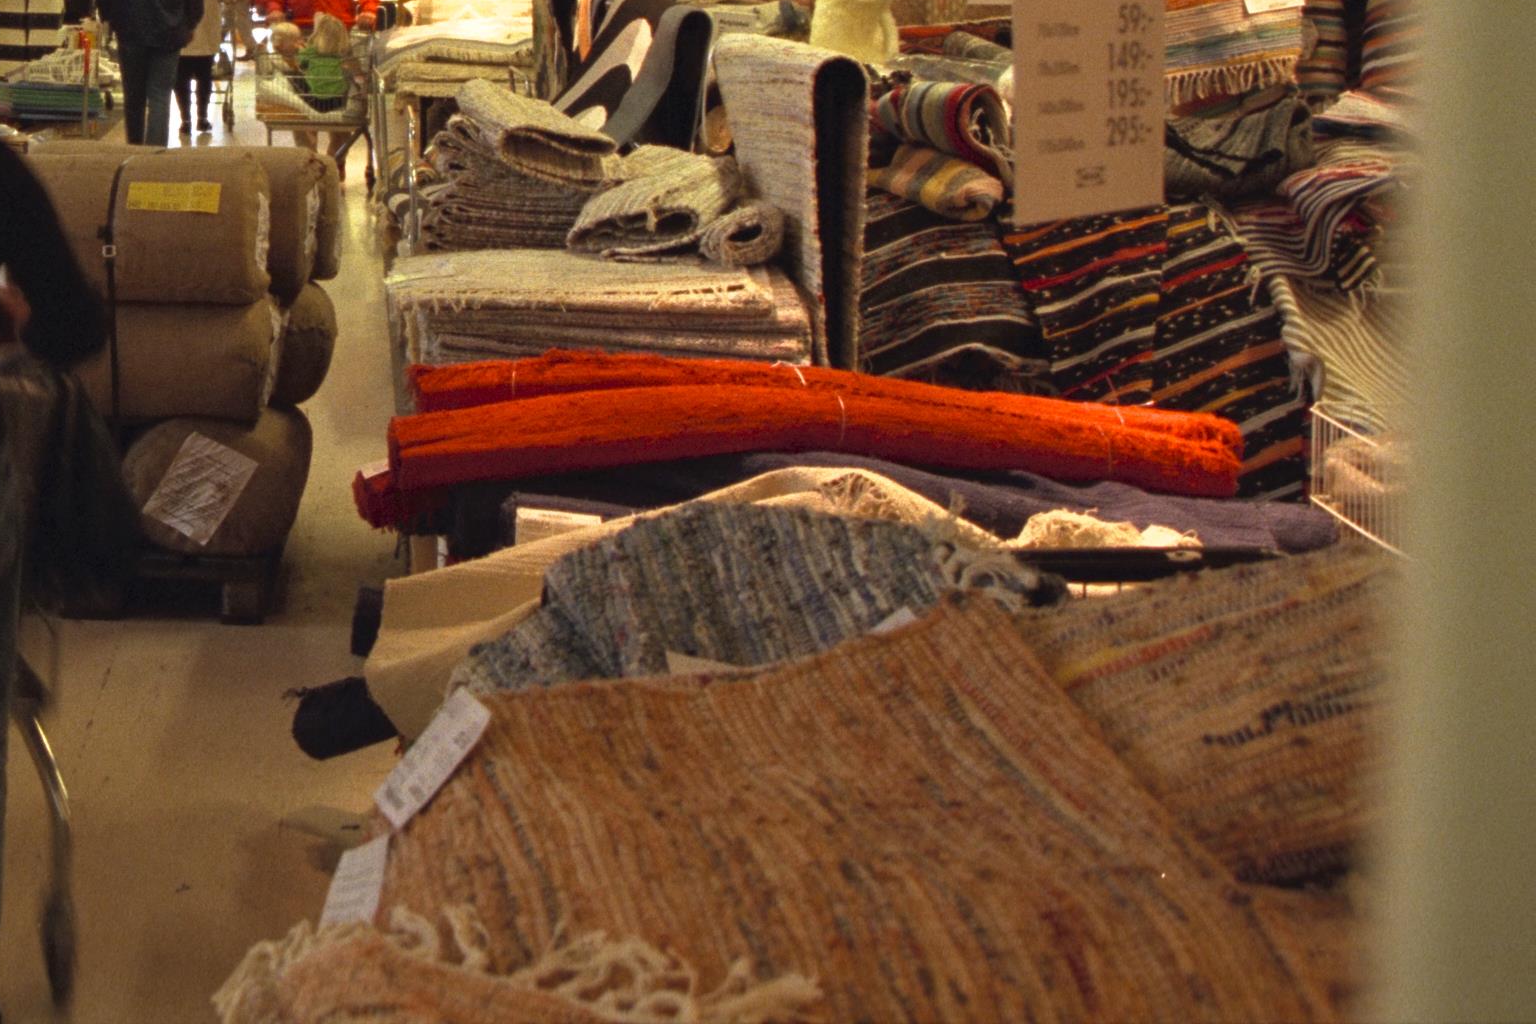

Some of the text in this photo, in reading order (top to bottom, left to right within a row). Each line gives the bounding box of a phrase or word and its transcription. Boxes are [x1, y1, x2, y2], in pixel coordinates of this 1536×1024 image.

[1119, 3, 1154, 34] 59:-
[1107, 40, 1153, 72] 149:-
[1107, 77, 1152, 110] 195:-
[1107, 114, 1152, 147] 295:-
